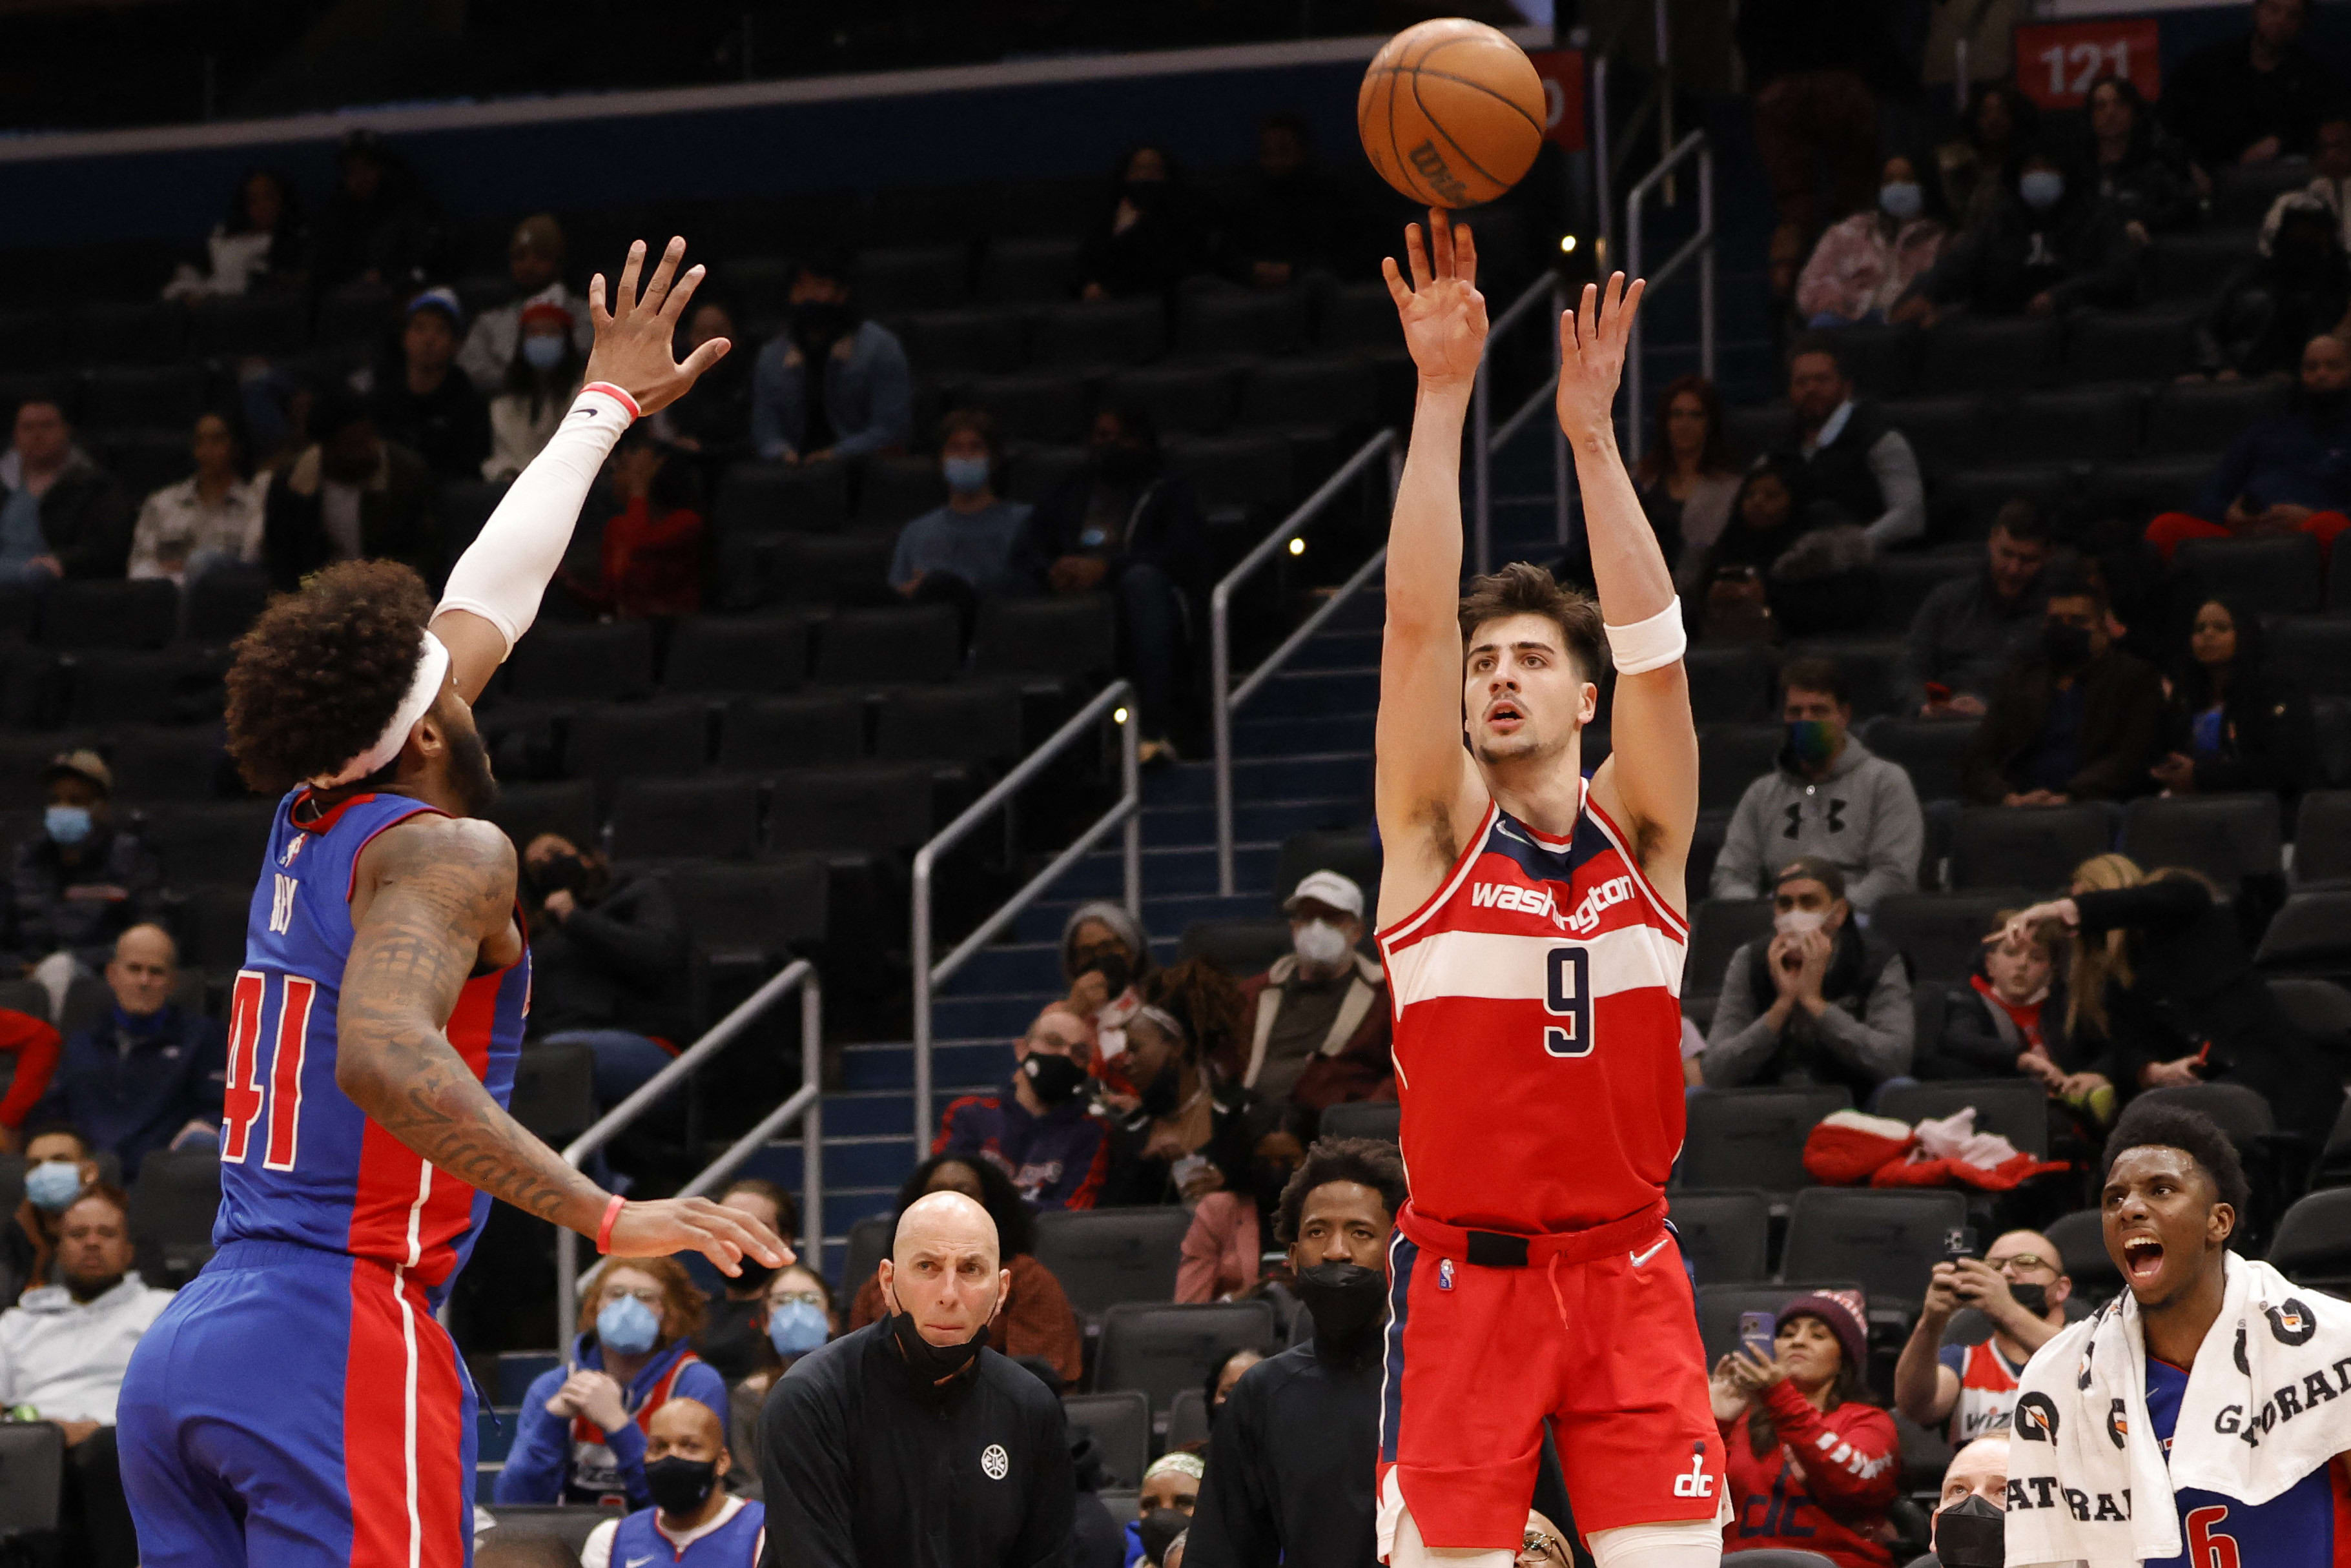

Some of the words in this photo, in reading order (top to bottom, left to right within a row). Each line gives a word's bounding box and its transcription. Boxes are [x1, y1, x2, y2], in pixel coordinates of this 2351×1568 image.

[2040, 41, 2129, 94] 121
[1543, 945, 1594, 1057] 9
[220, 970, 316, 1172] 41
[2185, 1505, 2241, 1568] 6
